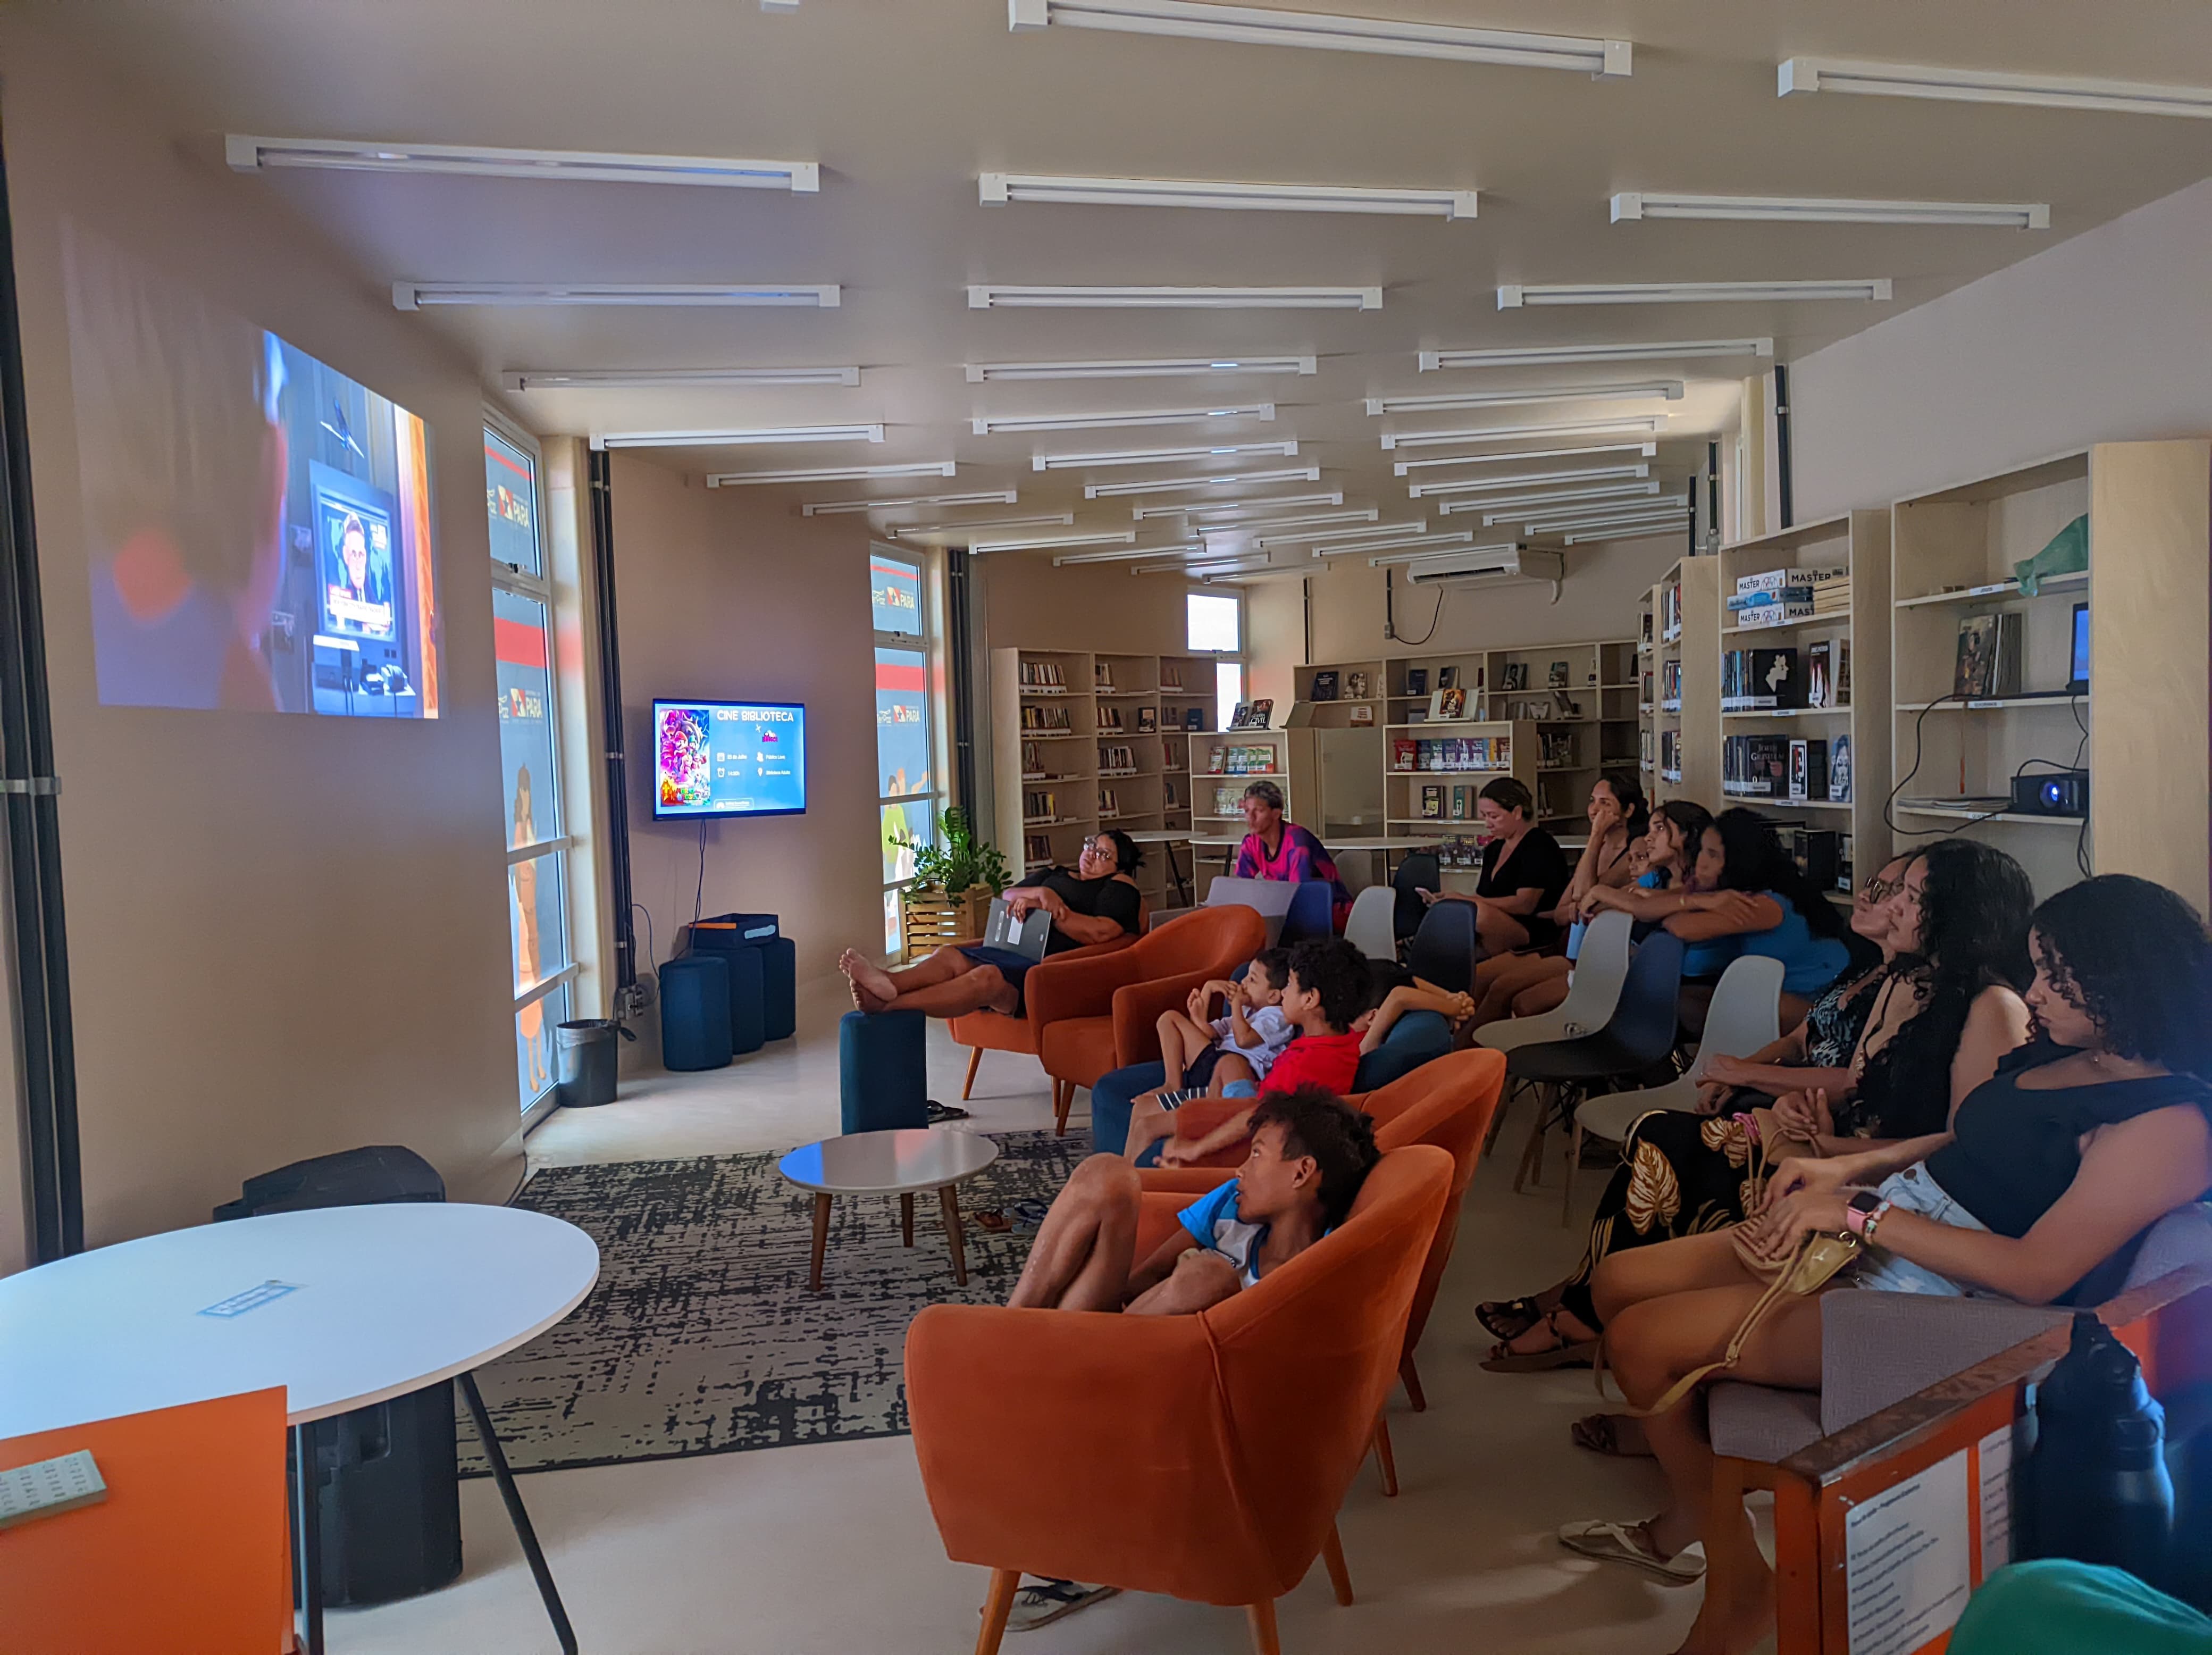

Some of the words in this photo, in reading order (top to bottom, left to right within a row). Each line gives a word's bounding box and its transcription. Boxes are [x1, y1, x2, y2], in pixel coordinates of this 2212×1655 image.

[1791, 573, 1831, 582] MASTER
[1739, 580, 1759, 590] MASTER
[900, 594, 915, 609] PARA
[1740, 613, 1760, 622] MASTER
[1789, 608, 1814, 616] MAST
[526, 697, 542, 718] PARA
[717, 710, 739, 721] CINE
[741, 711, 794, 722] BIBLIOTECA
[906, 710, 920, 722] PARA
